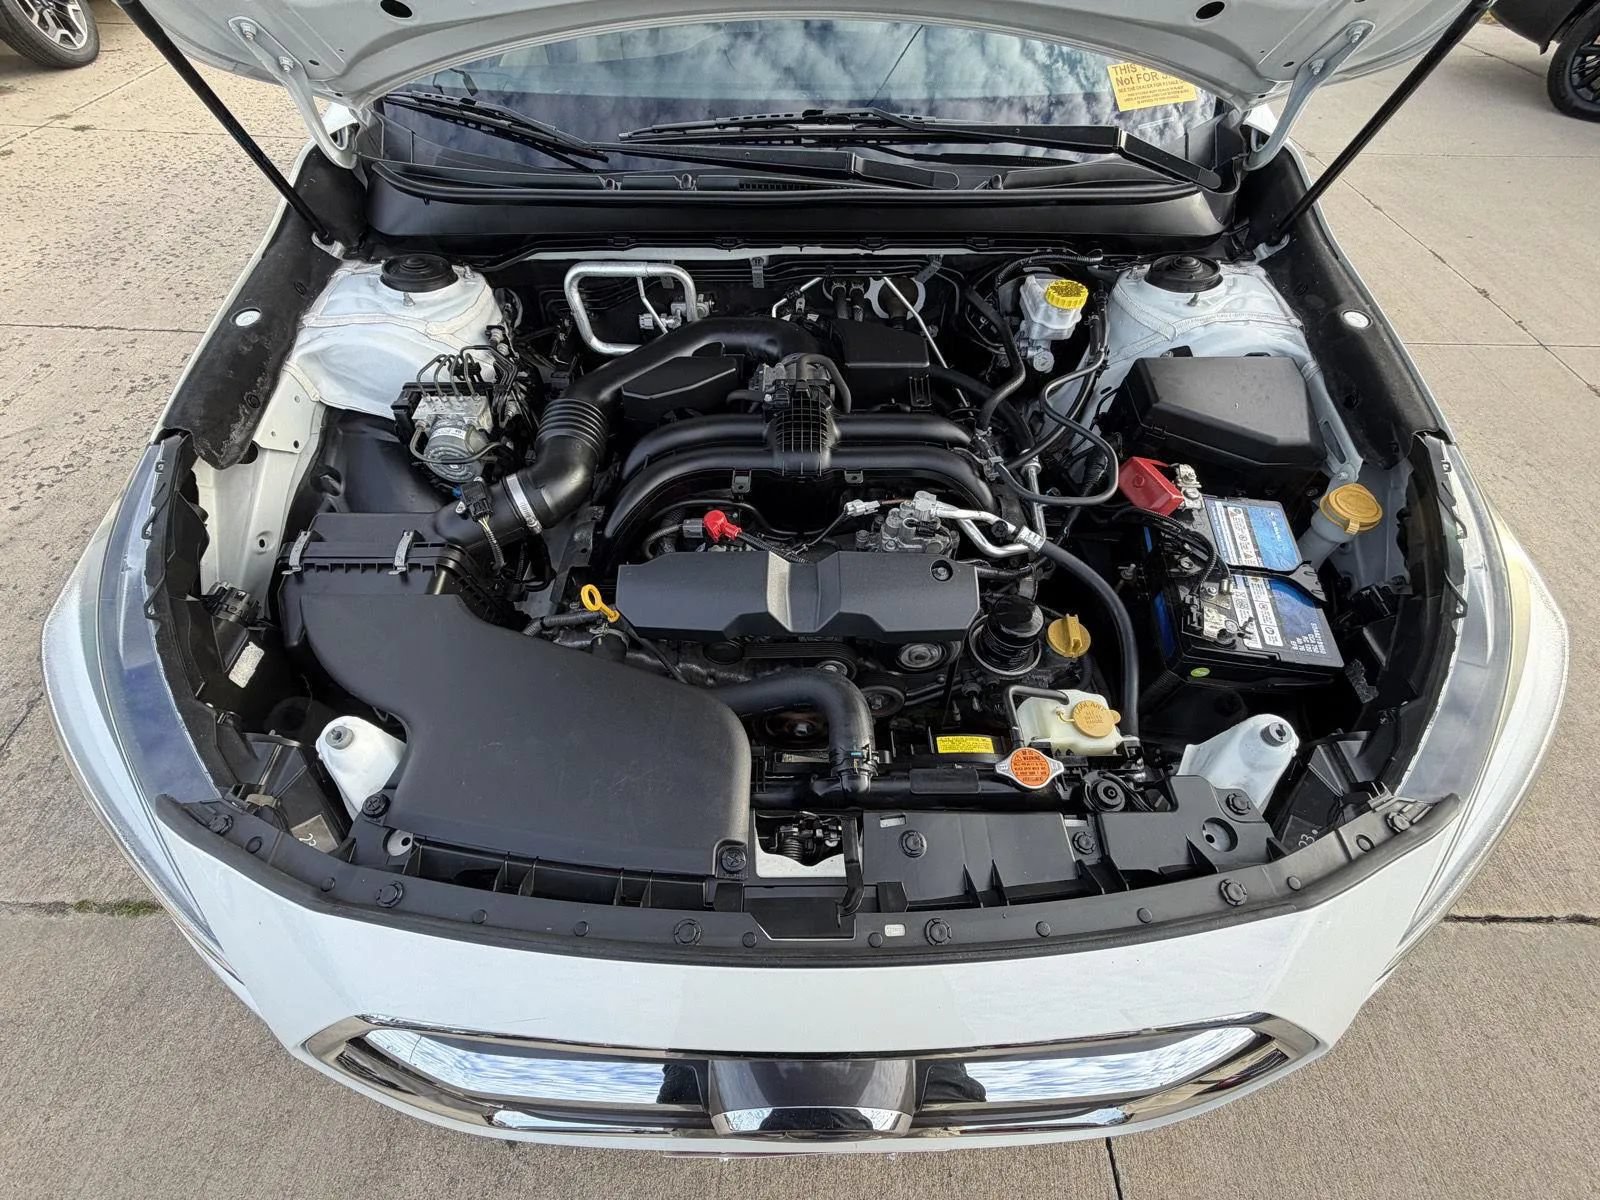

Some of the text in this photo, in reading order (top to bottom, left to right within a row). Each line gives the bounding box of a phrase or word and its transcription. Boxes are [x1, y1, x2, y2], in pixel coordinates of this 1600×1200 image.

[1112, 64, 1137, 76] THIS
[1115, 77, 1135, 87] Not
[1136, 71, 1159, 84] FOR
